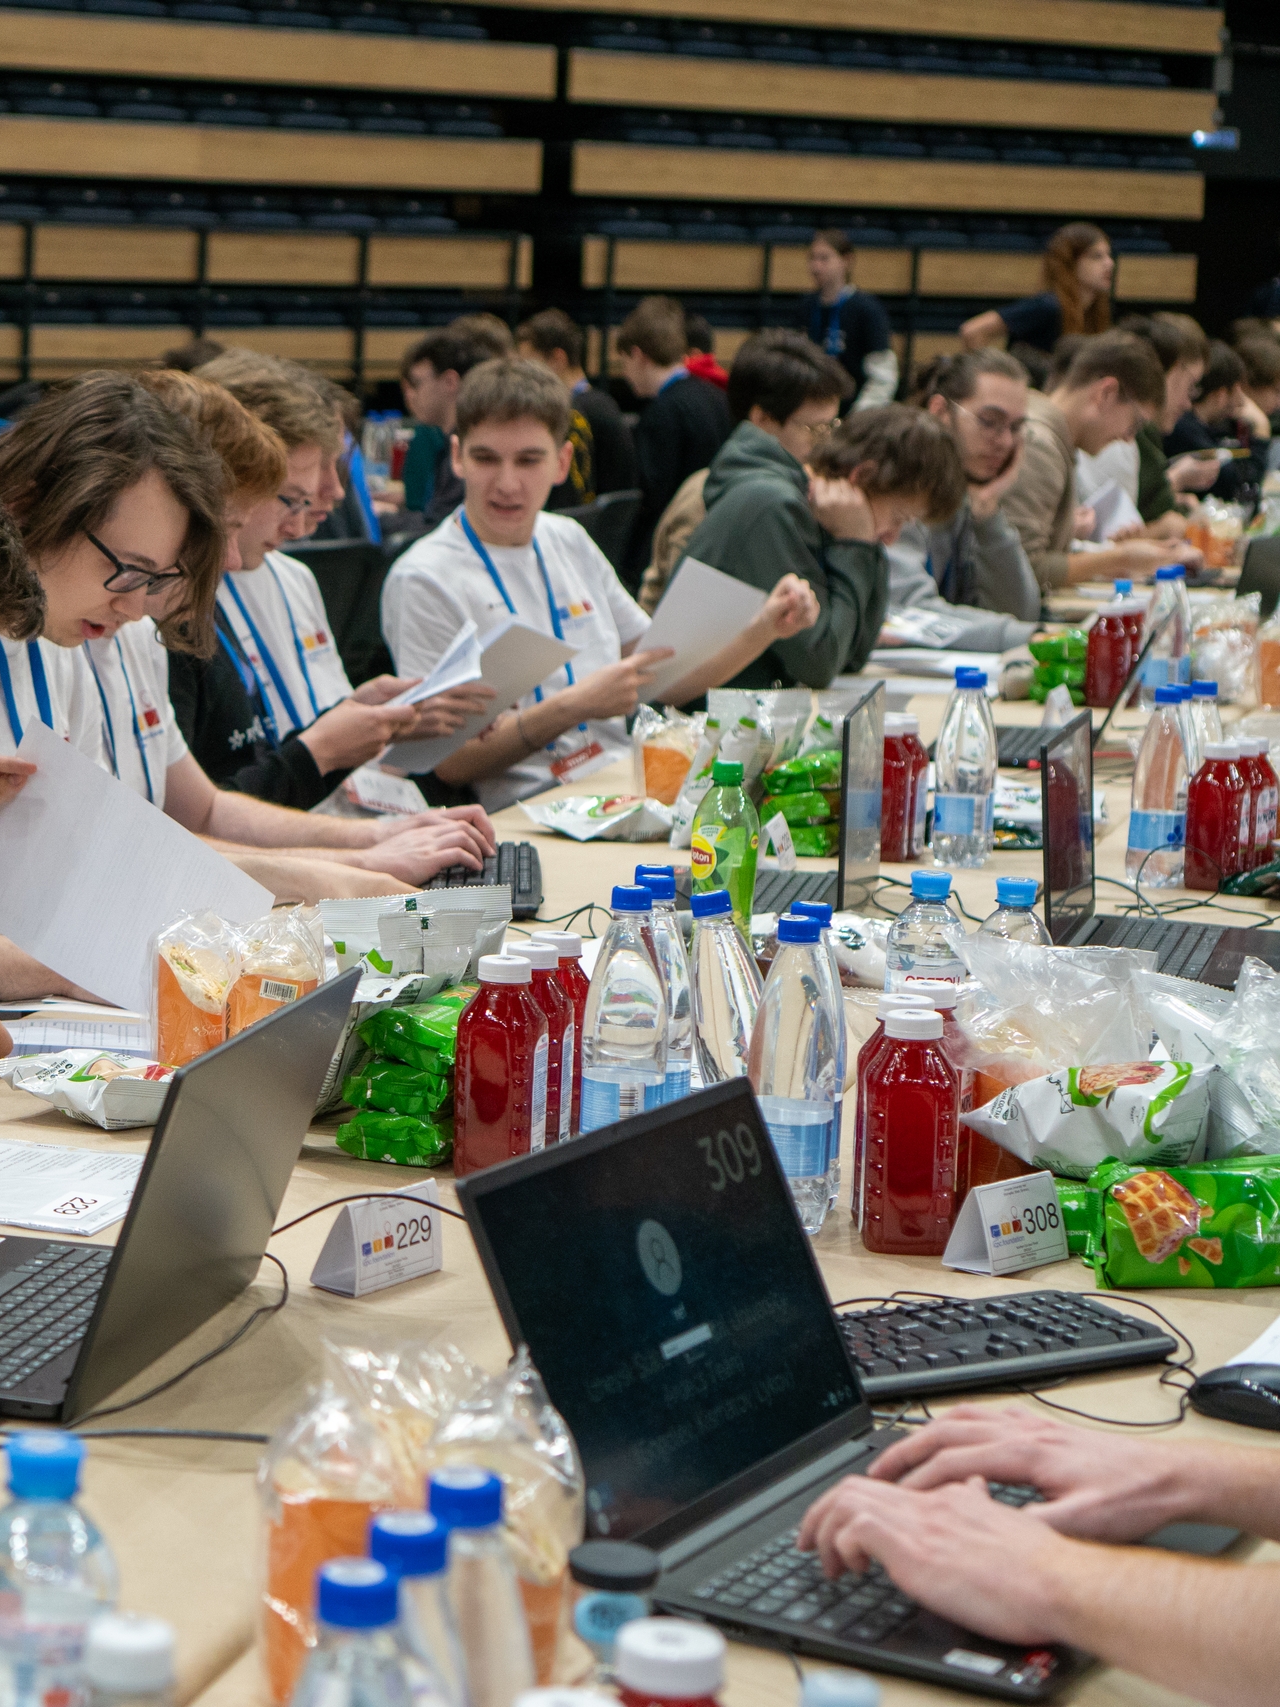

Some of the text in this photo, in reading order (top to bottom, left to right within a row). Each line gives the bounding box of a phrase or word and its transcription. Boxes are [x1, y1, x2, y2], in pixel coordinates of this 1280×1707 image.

[697, 1122, 763, 1192] 309
[53, 1196, 98, 1215] 229
[1023, 1202, 1059, 1235] 308
[396, 1214, 432, 1250] 229
